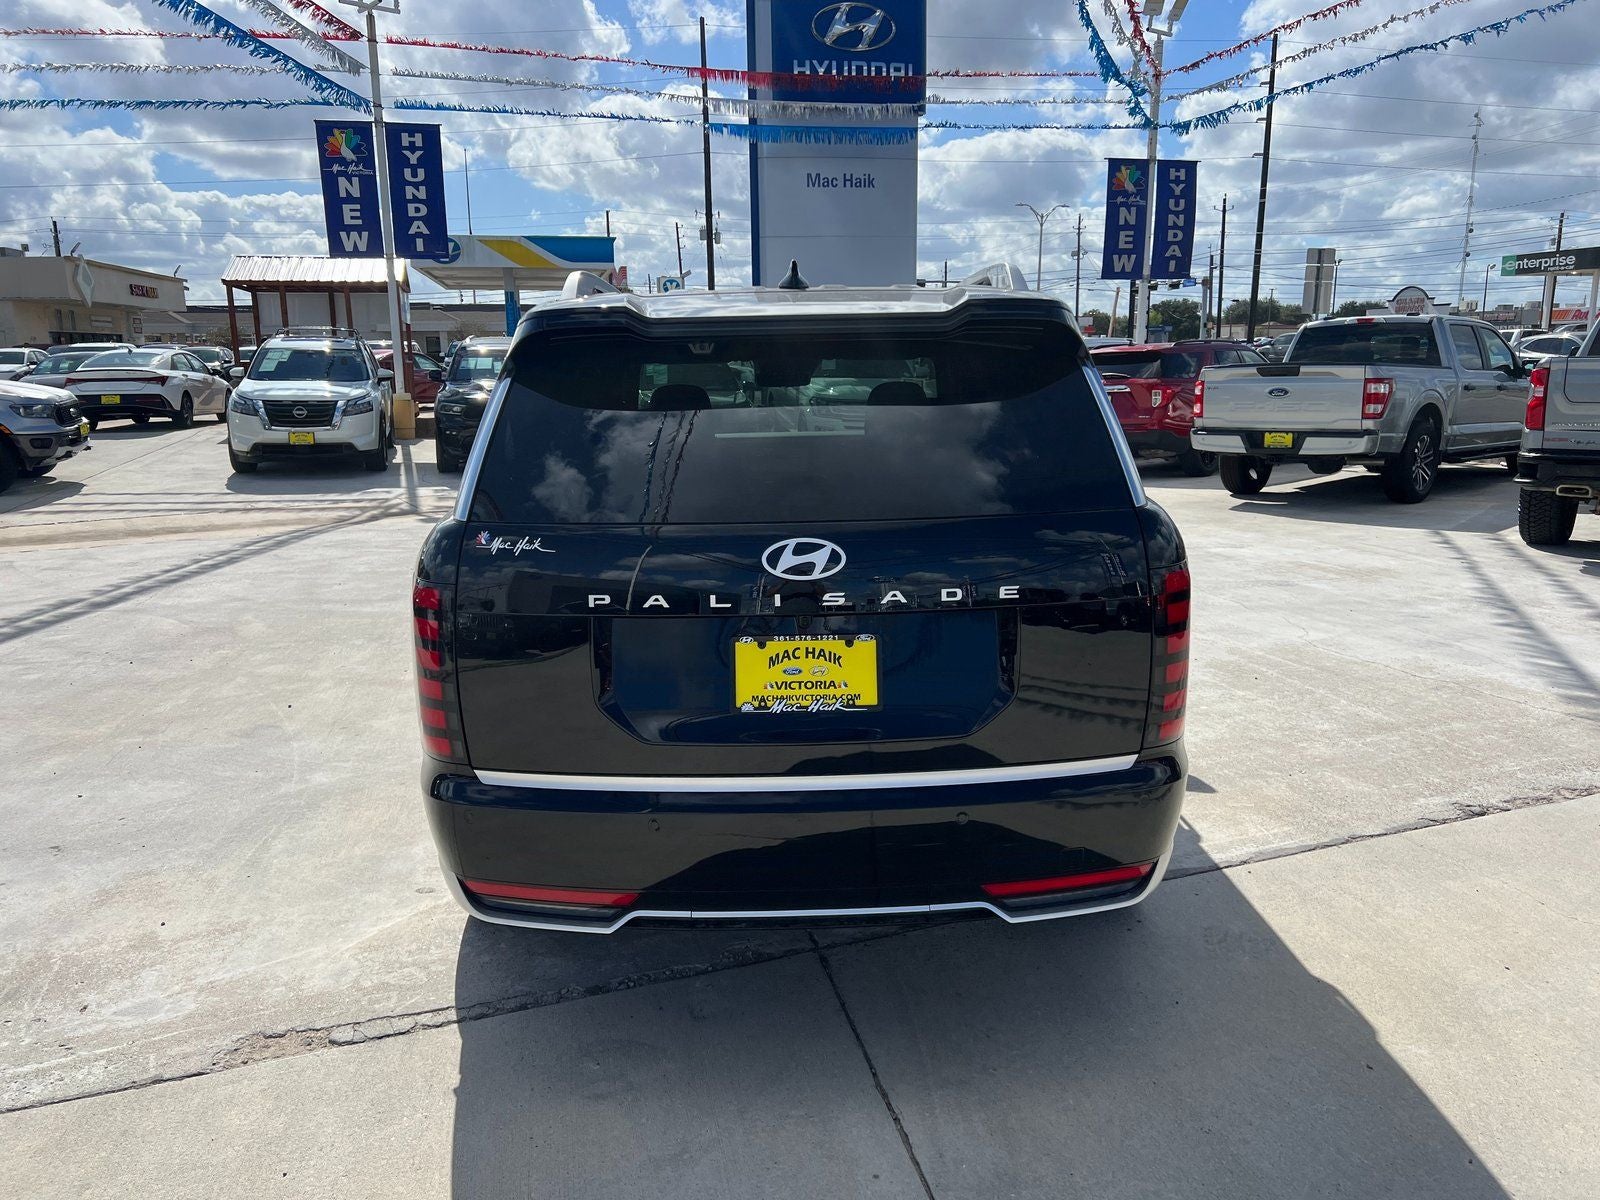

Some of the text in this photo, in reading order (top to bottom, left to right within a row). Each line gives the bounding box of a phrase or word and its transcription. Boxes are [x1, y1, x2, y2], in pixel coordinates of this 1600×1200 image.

[793, 60, 913, 79] HYUNDAI
[806, 172, 875, 189] Mac Haik
[401, 132, 430, 252] HYUNDAI
[338, 176, 368, 252] NEW
[1165, 168, 1186, 272] HYUNDAI
[1113, 206, 1137, 273] NEW
[1502, 253, 1576, 271] enterprise
[1547, 264, 1575, 272] rent-a-car
[490, 536, 550, 556] Mac Haik
[588, 585, 1021, 607] PALISADE
[773, 634, 839, 642] 361-576-1221
[768, 646, 843, 670] MAC HAIK
[774, 680, 838, 690] VICTORIA
[751, 693, 861, 703] MACHAIKVICTORIA.COM
[769, 698, 851, 713] Mac Haik
